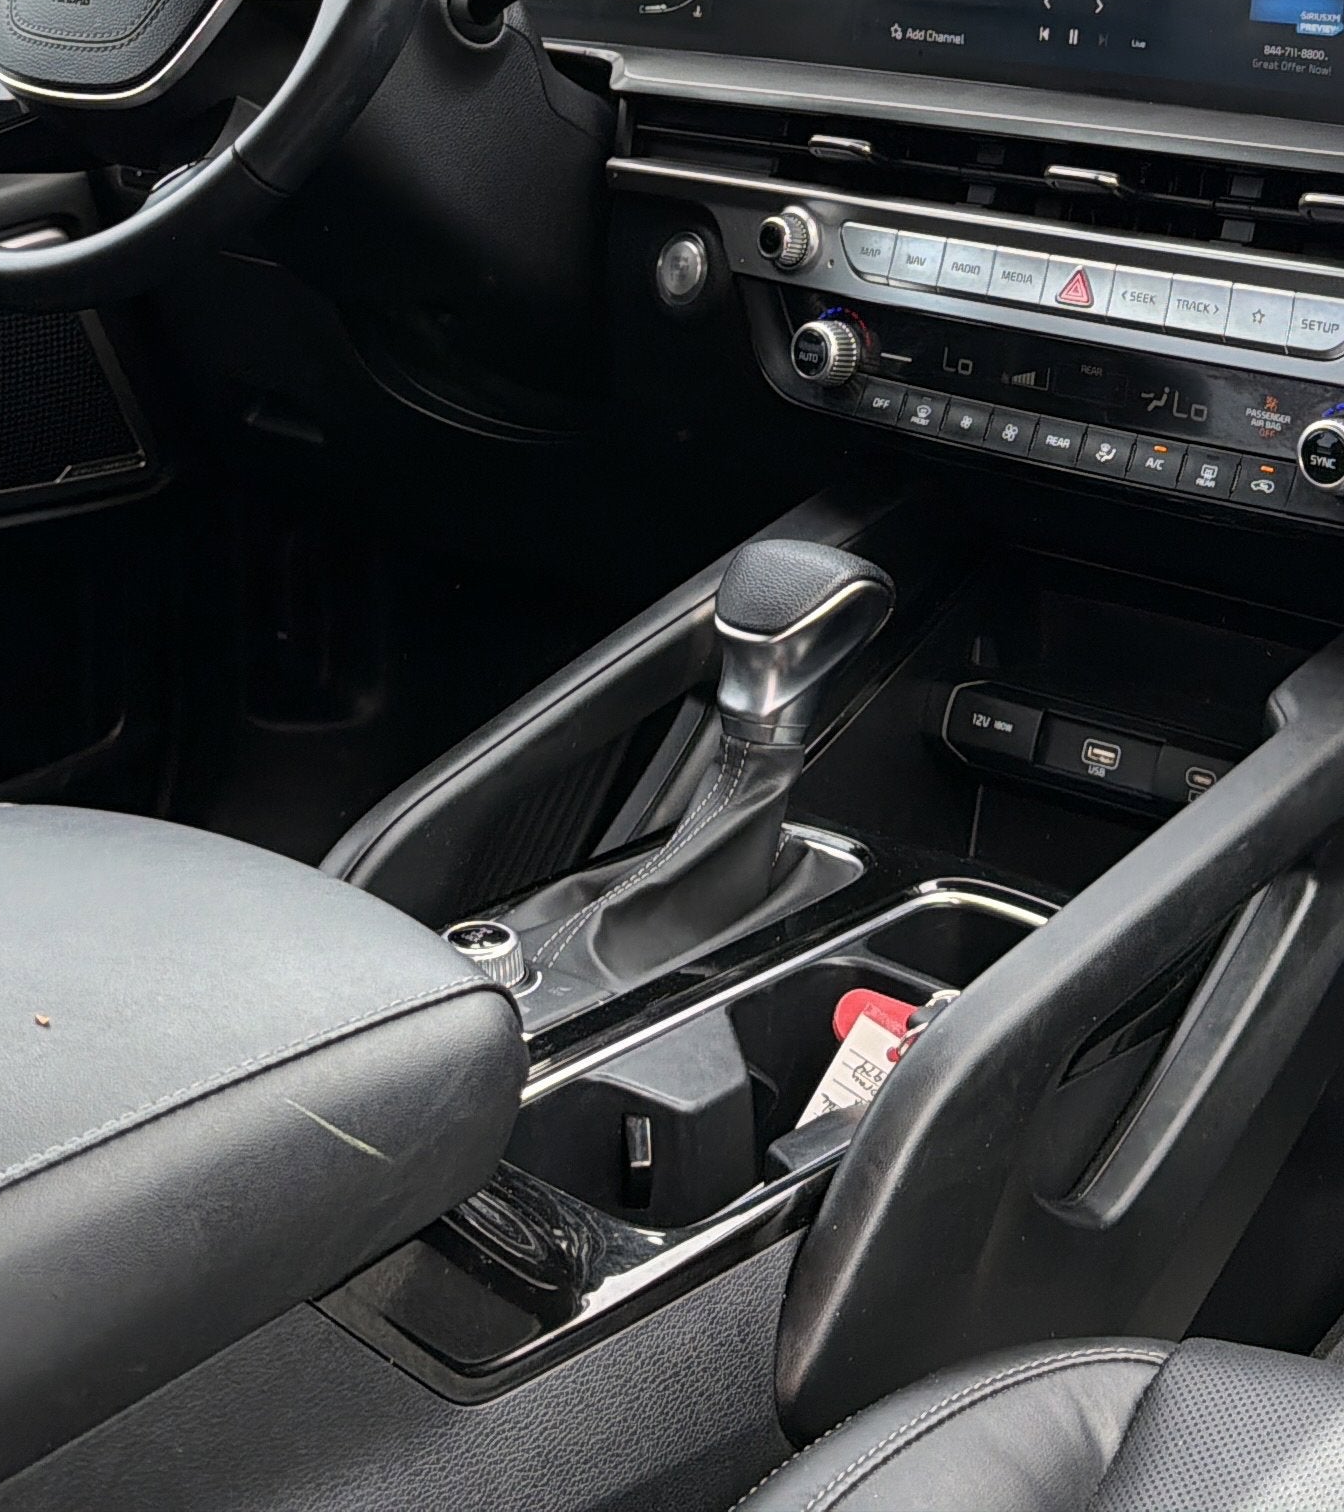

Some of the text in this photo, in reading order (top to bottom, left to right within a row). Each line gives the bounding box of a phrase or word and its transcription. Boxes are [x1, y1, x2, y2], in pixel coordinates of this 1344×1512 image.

[1300, 11, 1341, 23] SIRIUSXM
[906, 28, 964, 45] Add Channel
[1131, 39, 1146, 49] Live
[1252, 59, 1332, 76] Great Offer Now!
[861, 246, 881, 258] MAP
[906, 254, 927, 266] NAV
[951, 261, 981, 275] RADIO
[1001, 270, 1033, 284] MEDIA
[1130, 291, 1156, 305] SEEK
[1176, 298, 1210, 314] TRACK
[1301, 318, 1340, 334] SETUP
[798, 351, 819, 364] AUTO
[1080, 364, 1103, 377] REAR
[872, 397, 891, 410] OFF
[1245, 408, 1291, 424] PASSENGER
[1251, 417, 1282, 431] AIR BAG
[1258, 428, 1276, 437] OFF
[1045, 435, 1071, 449] REAR
[1144, 457, 1165, 470] A/C
[1309, 454, 1336, 469] SYNC
[1195, 477, 1216, 488] REAR
[972, 712, 990, 728] 12V
[1088, 763, 1106, 778] USB
